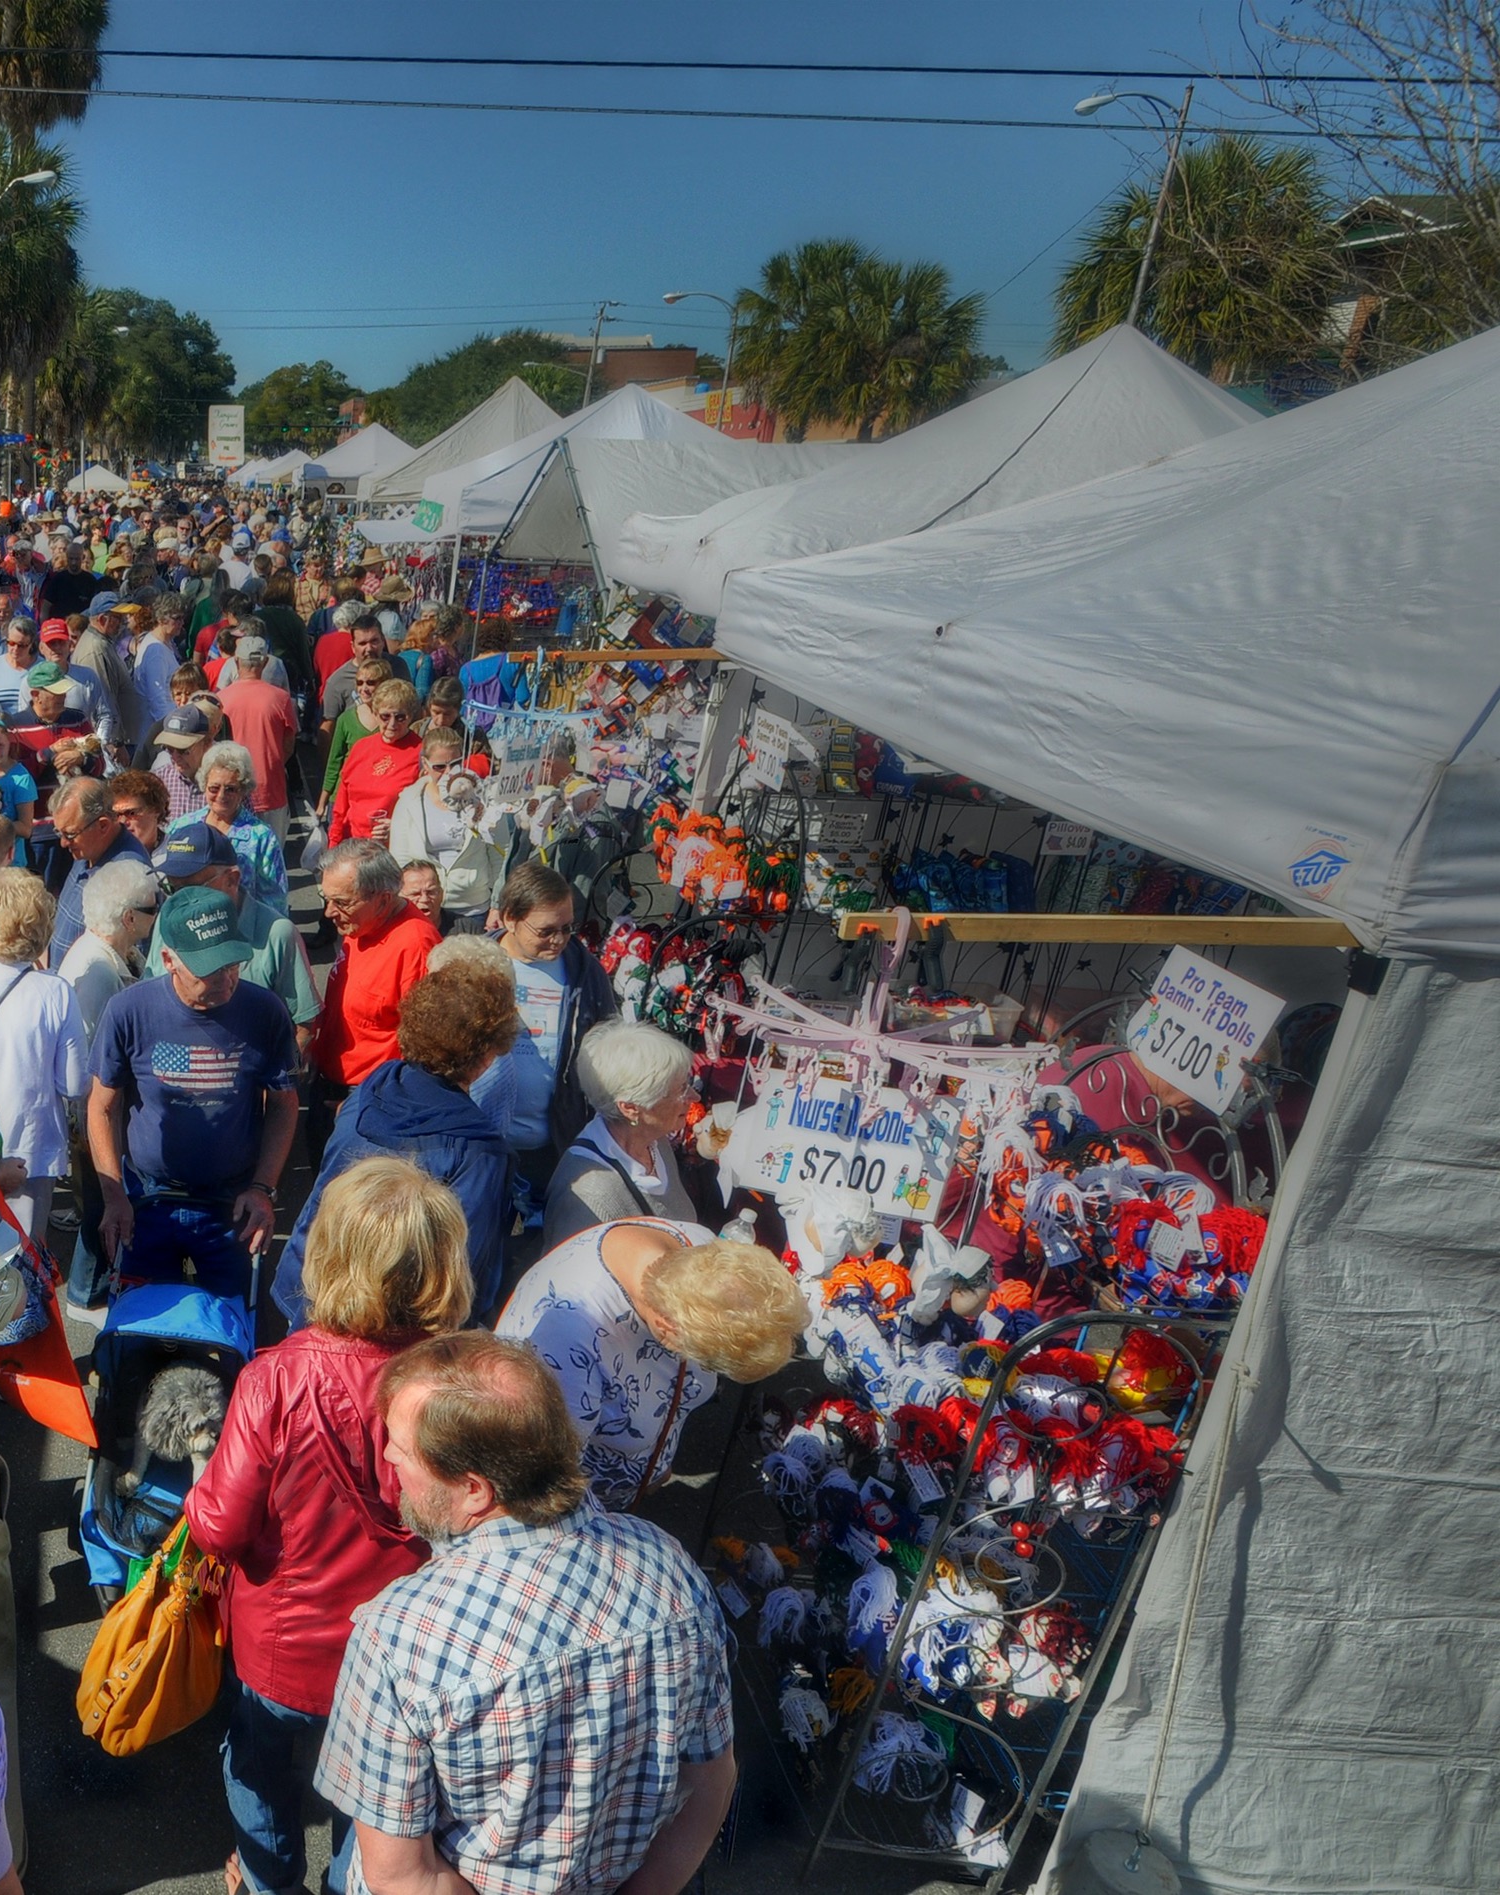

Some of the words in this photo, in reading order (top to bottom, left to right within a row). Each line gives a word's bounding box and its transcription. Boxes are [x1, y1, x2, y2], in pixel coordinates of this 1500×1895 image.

[756, 748, 776, 778] $7.00
[500, 774, 520, 796] $7.00
[1048, 822, 1091, 833] Pillows
[1066, 835, 1088, 849] $4.00
[186, 909, 228, 931] Rochester
[195, 923, 229, 942] Turners
[1180, 966, 1206, 994] Pro
[1207, 980, 1249, 1019] Team
[1156, 975, 1195, 1013] Damn
[1201, 1003, 1218, 1026] it
[1215, 1012, 1256, 1048] Dolls
[1151, 1015, 1212, 1080] $7.00
[788, 1083, 844, 1134] Nurse
[800, 1144, 886, 1194] $7.00
